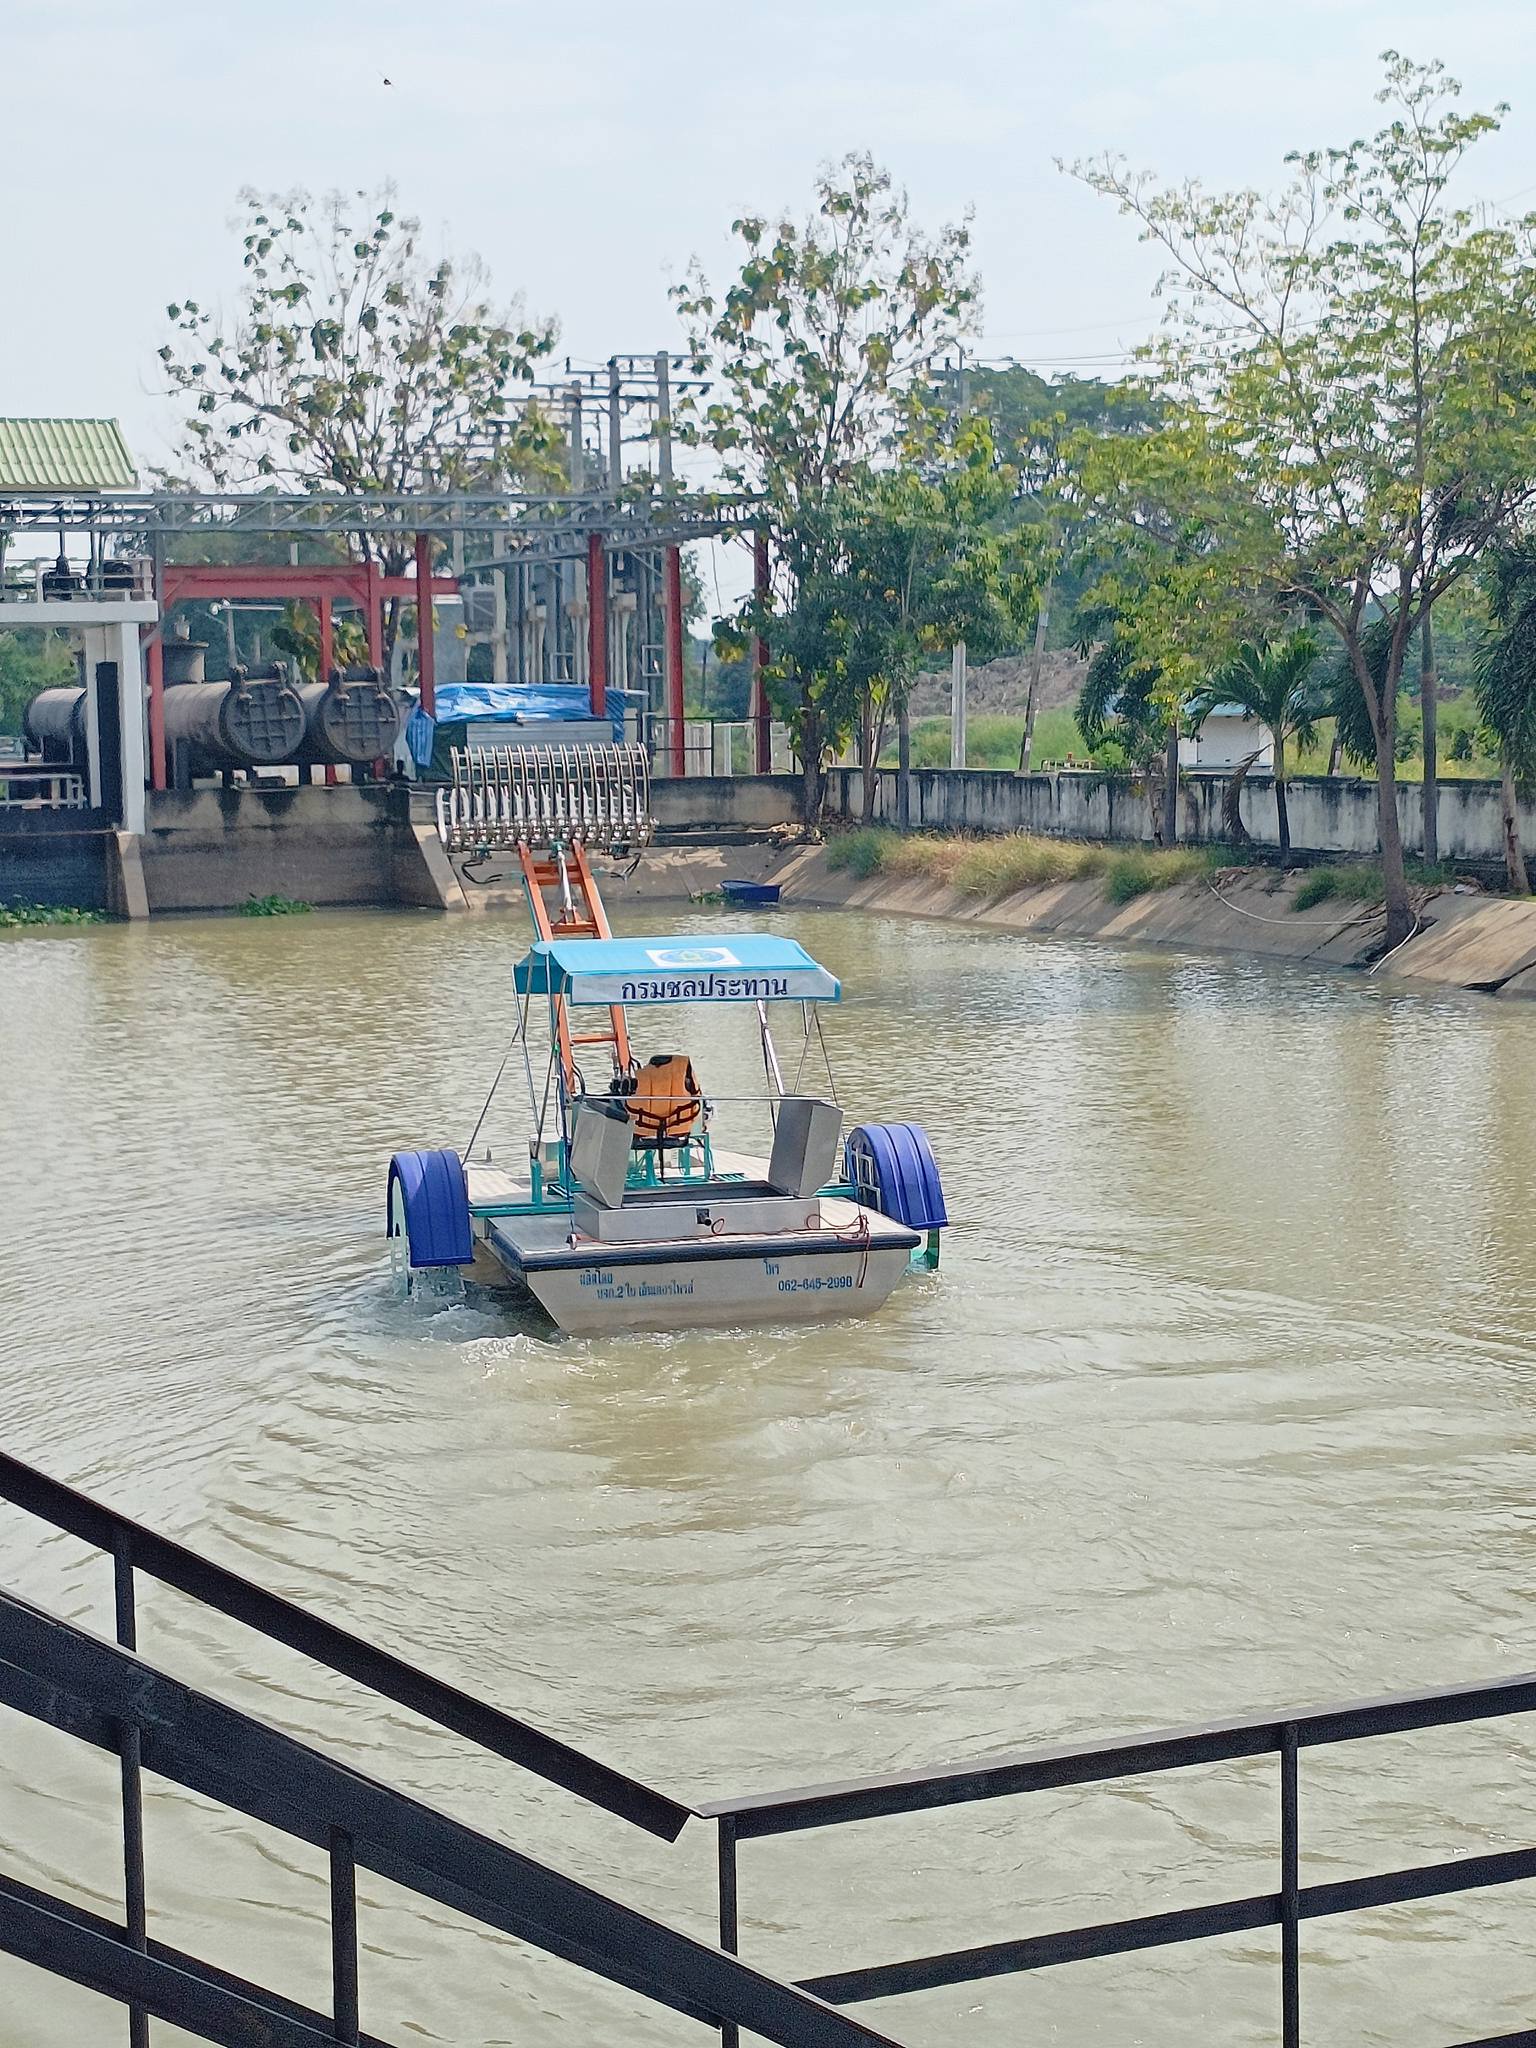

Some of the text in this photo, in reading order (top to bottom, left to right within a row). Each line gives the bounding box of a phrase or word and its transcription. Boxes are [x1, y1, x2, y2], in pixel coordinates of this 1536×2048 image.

[622, 973, 787, 999] กรมชลประทาน
